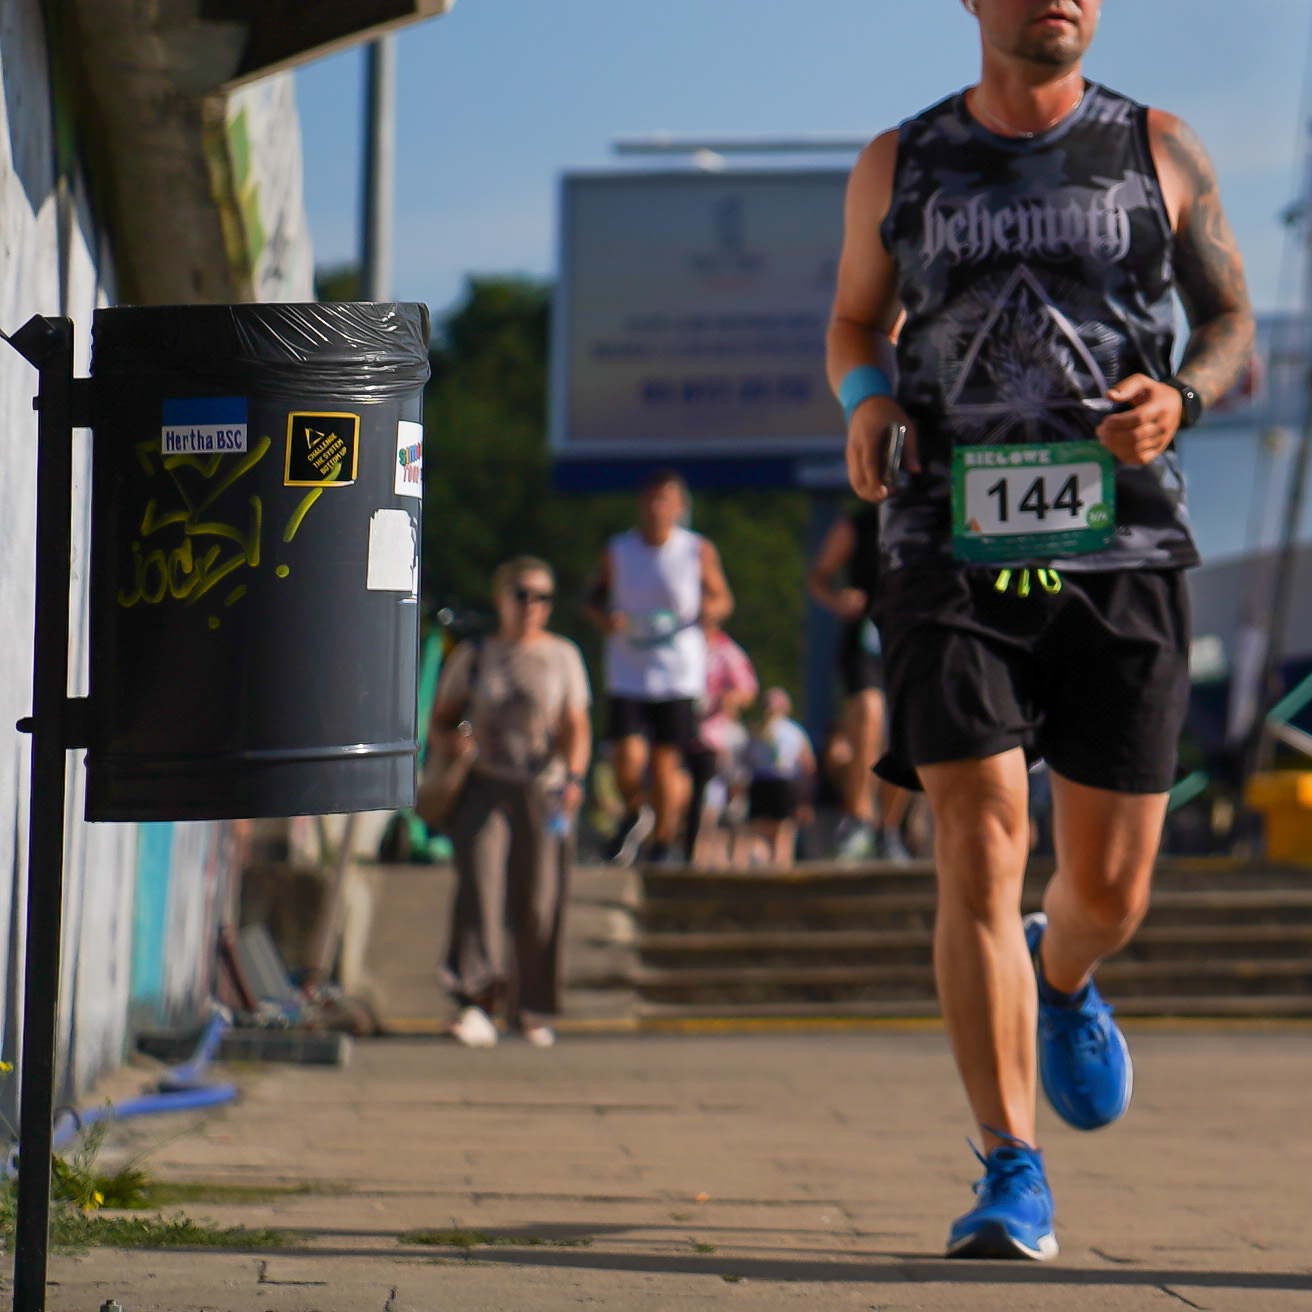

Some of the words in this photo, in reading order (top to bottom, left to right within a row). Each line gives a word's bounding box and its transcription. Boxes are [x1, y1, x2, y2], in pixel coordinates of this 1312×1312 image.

[166, 428, 213, 451] Hertha
[216, 429, 242, 449] BSC
[307, 432, 337, 462] CHALLENGE
[313, 455, 325, 468] THE
[323, 438, 344, 459] SYSTEM
[320, 453, 341, 474] BOTTOM
[339, 446, 347, 456] UP
[988, 473, 1084, 522] 144
